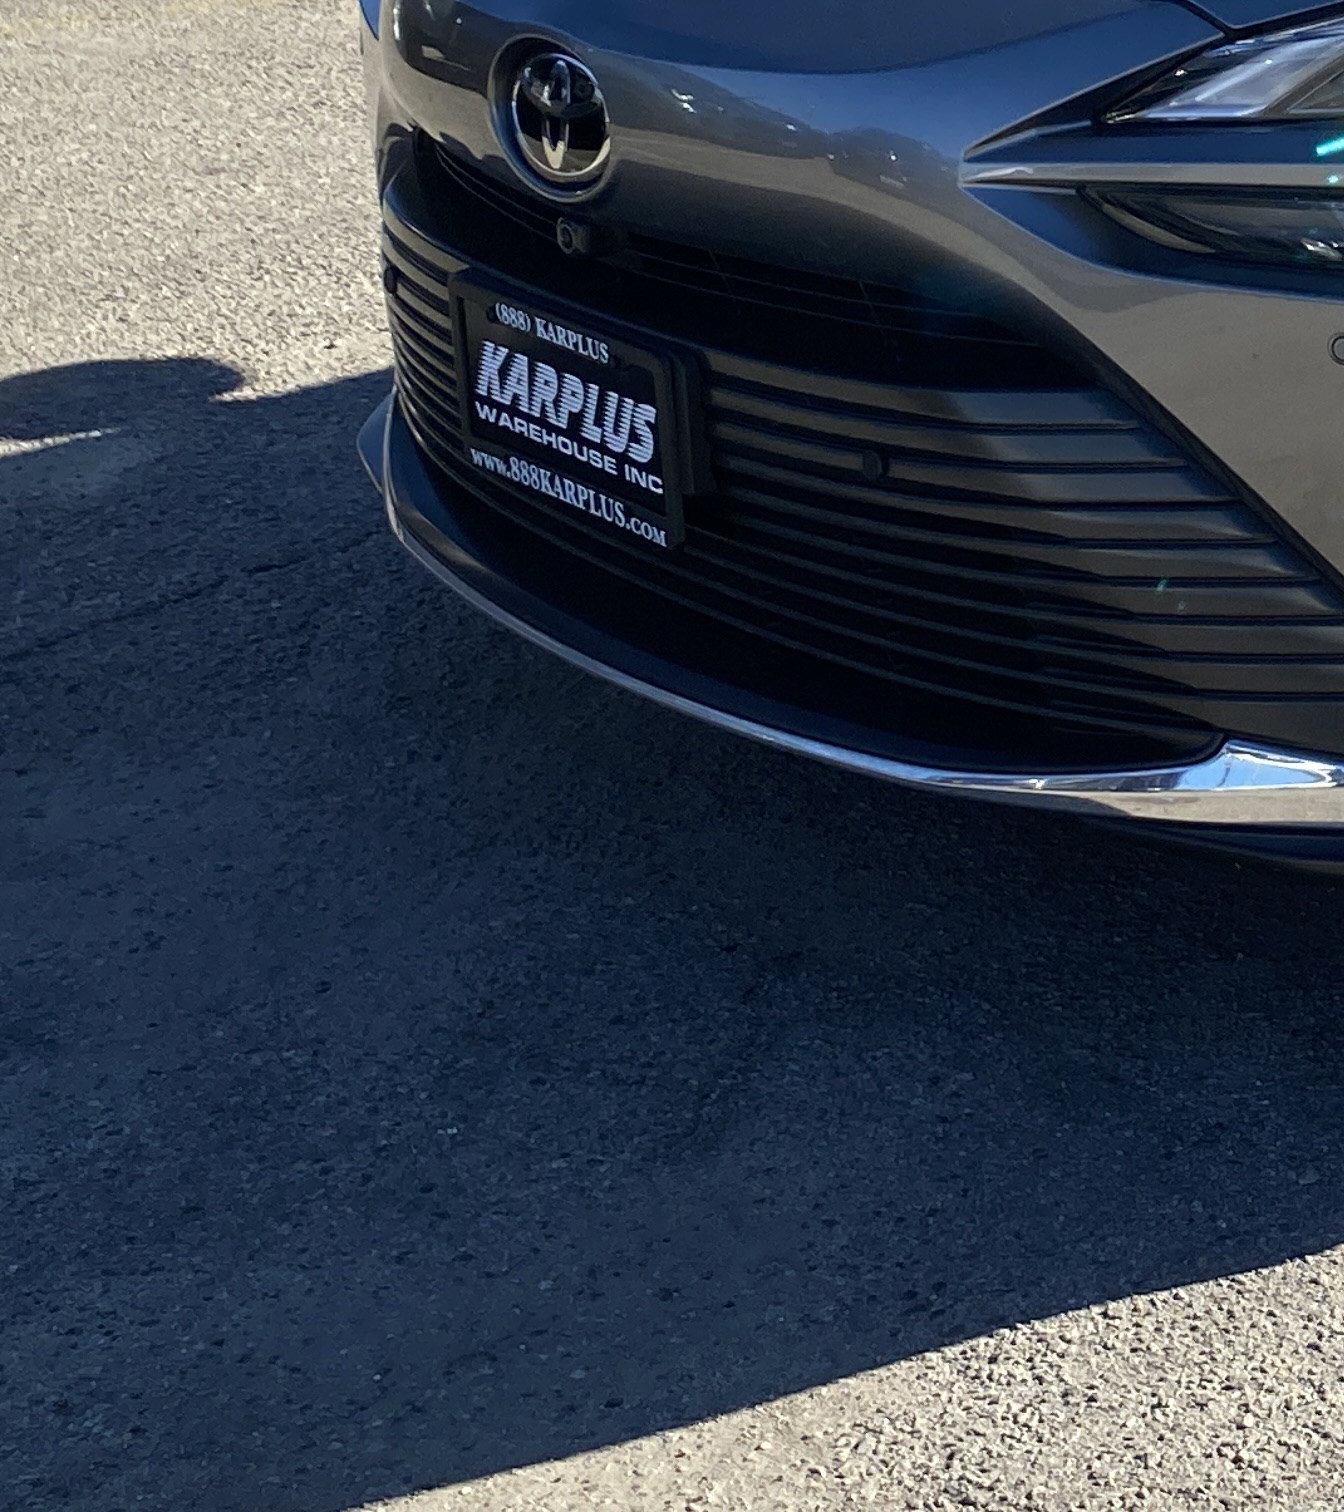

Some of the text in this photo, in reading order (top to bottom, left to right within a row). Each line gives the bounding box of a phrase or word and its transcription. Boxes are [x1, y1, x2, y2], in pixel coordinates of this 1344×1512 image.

[495, 302, 610, 364] (888) KARPLUS
[474, 339, 658, 464] KARPLUS
[474, 400, 665, 495] WAREHOUSE INC
